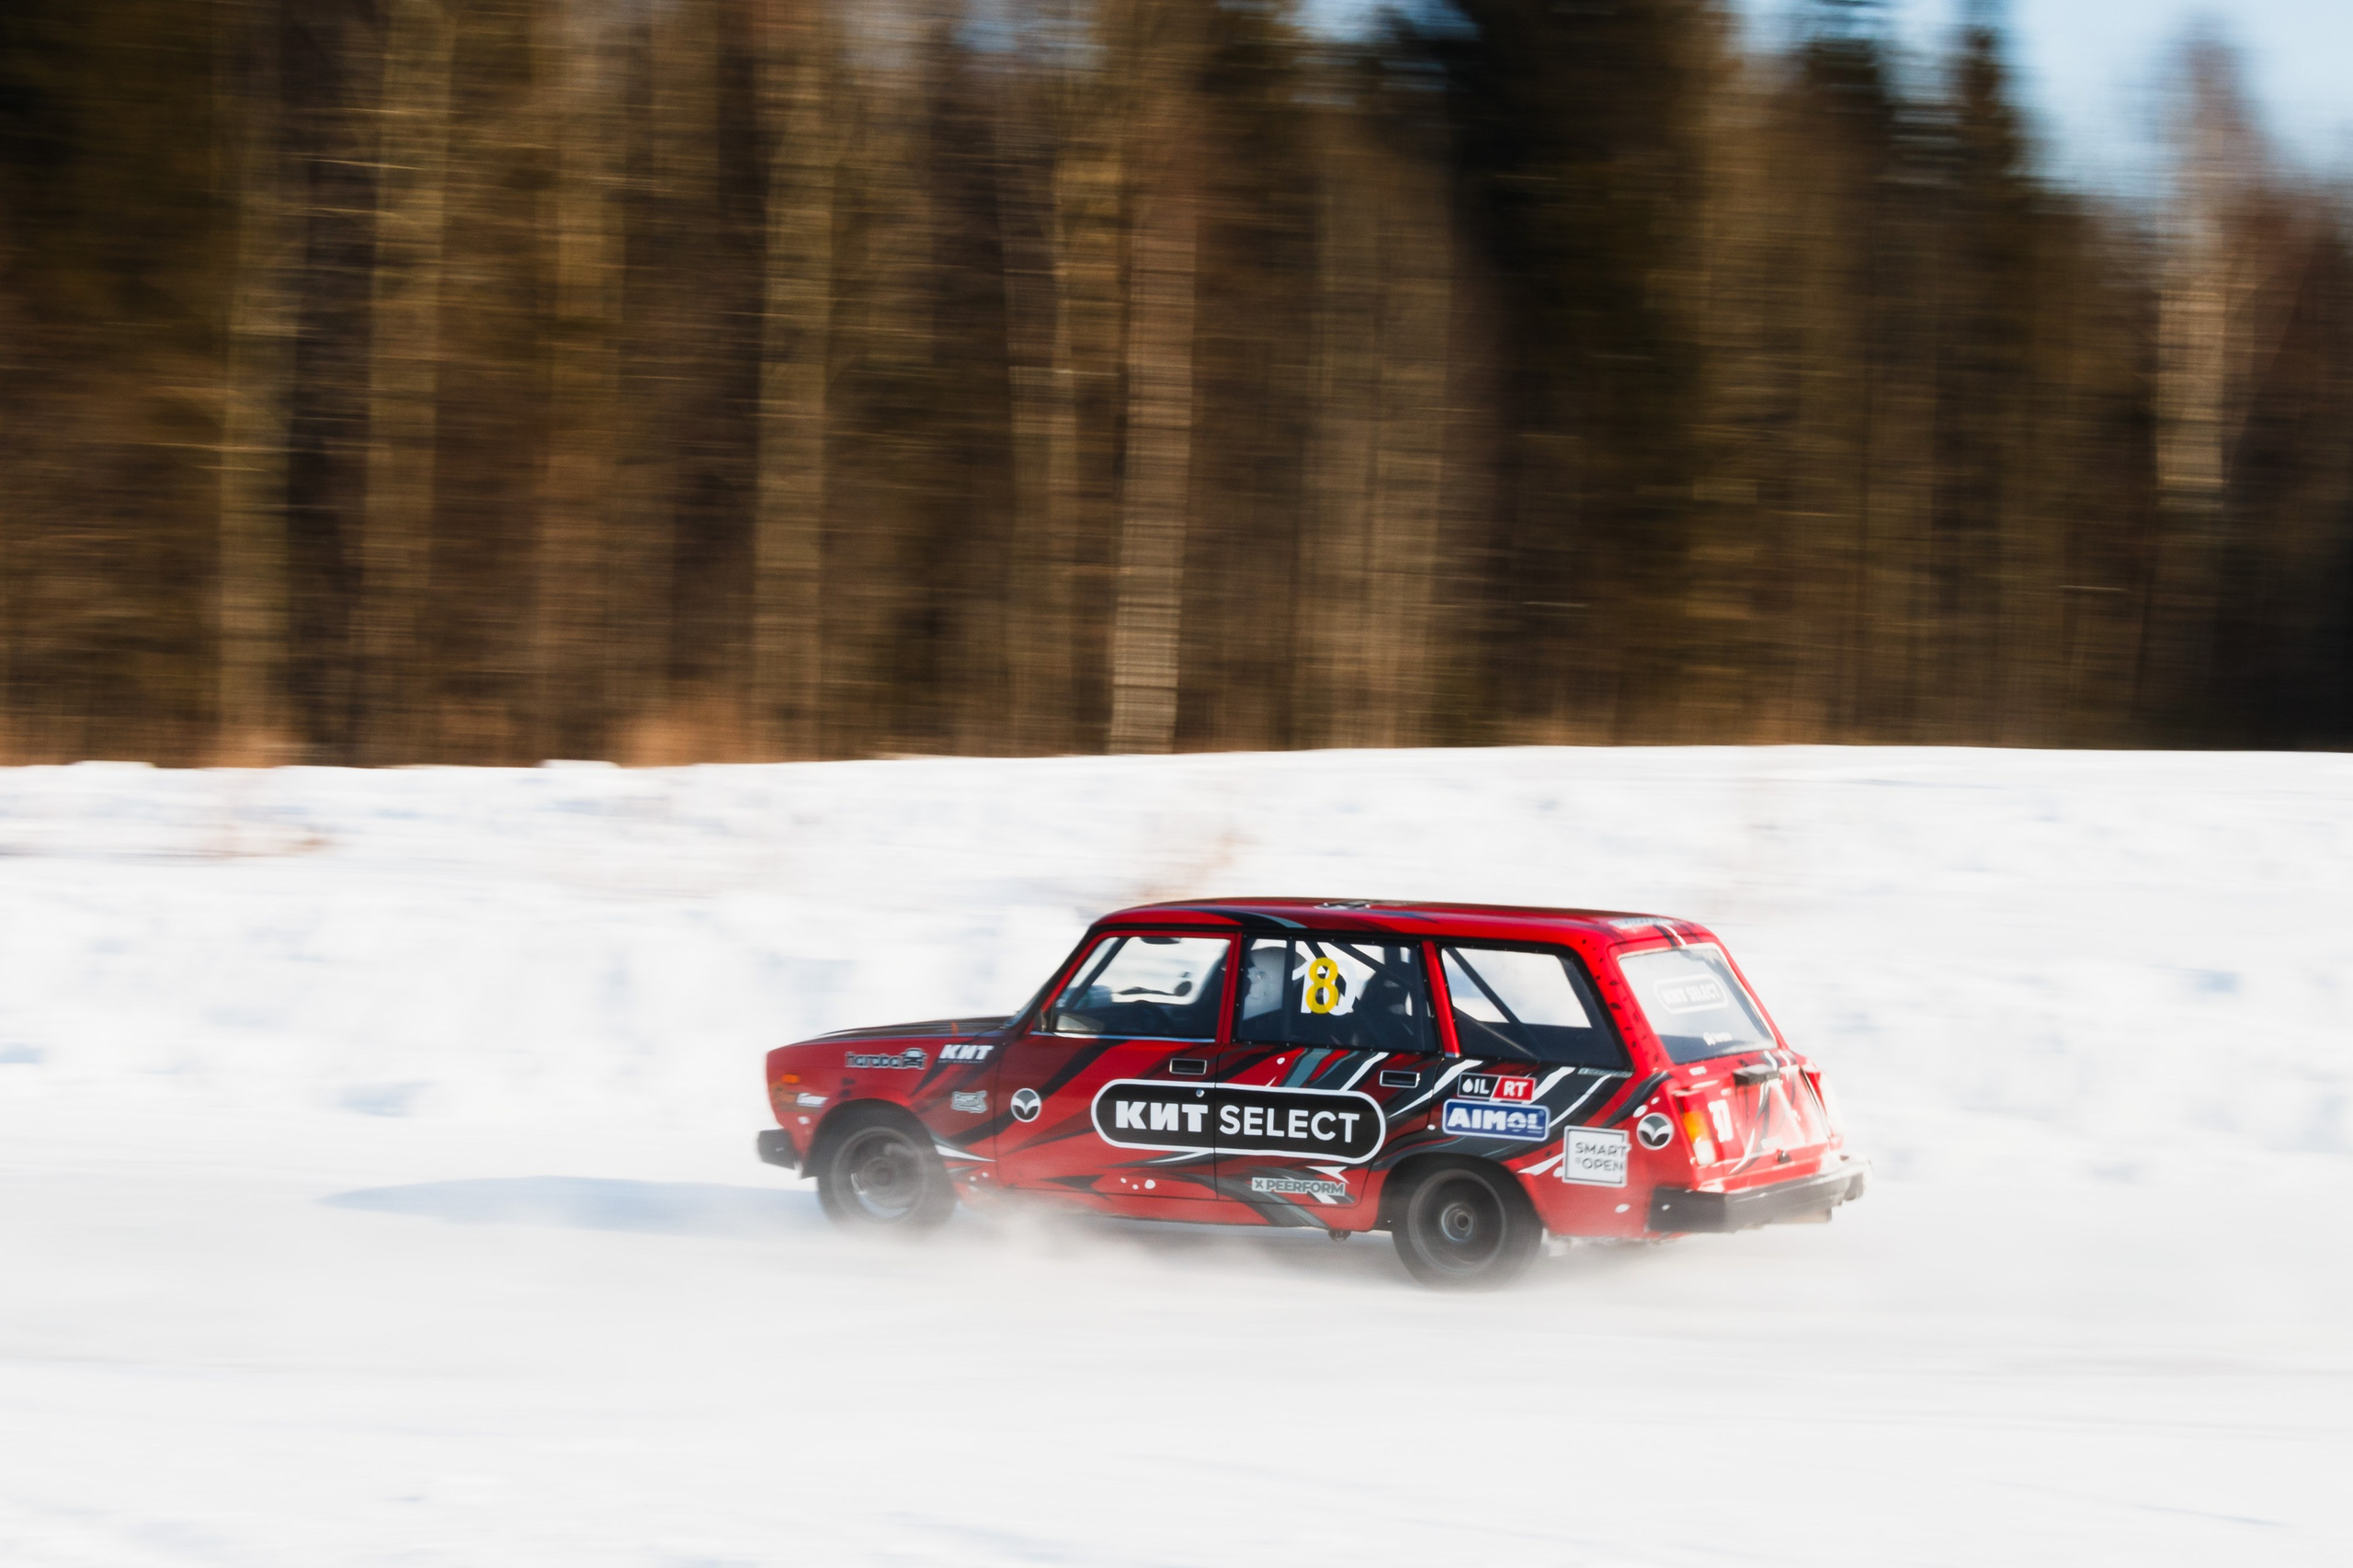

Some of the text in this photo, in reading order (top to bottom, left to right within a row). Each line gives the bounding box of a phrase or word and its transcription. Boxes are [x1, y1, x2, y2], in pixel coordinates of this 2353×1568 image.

[1306, 957, 1339, 1014] 8
[938, 1044, 995, 1060] КИТ
[1503, 1080, 1529, 1097] RT
[1115, 1100, 1360, 1142] КИТ SELECT
[1447, 1107, 1544, 1134] AIMOL
[1574, 1142, 1628, 1157] SMART
[1582, 1157, 1623, 1172] OPEN
[1266, 1179, 1345, 1194] PEERFORM
